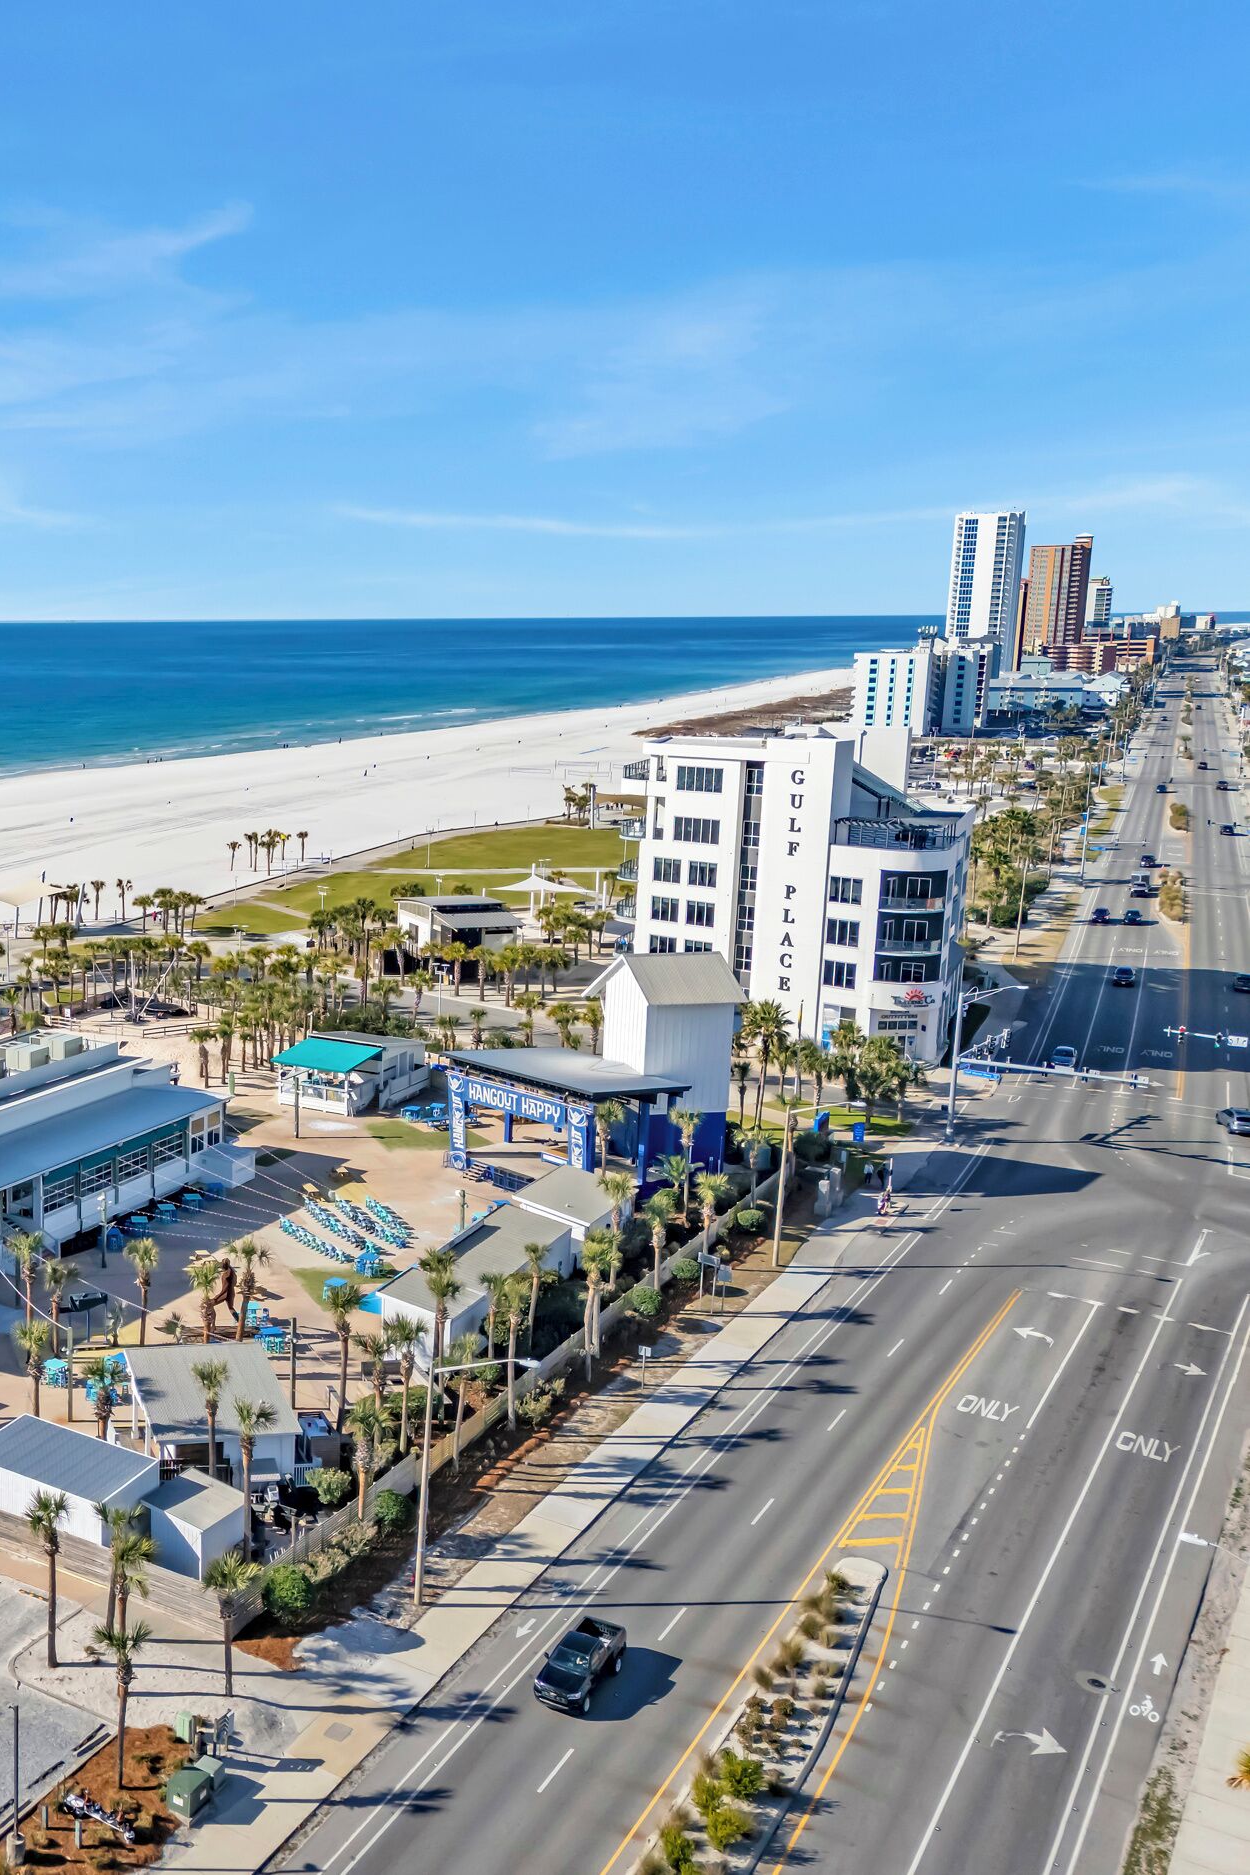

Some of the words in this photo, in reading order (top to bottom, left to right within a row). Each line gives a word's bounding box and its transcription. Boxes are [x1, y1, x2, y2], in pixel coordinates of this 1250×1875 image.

[786, 769, 806, 857] GULF
[777, 884, 797, 992] PLACE
[1140, 1049, 1173, 1058] ONLY
[468, 1082, 518, 1111] HANGOUT
[521, 1096, 561, 1123] HAPPY
[955, 1394, 1020, 1422] ONLY
[1115, 1431, 1181, 1463] ONLY
